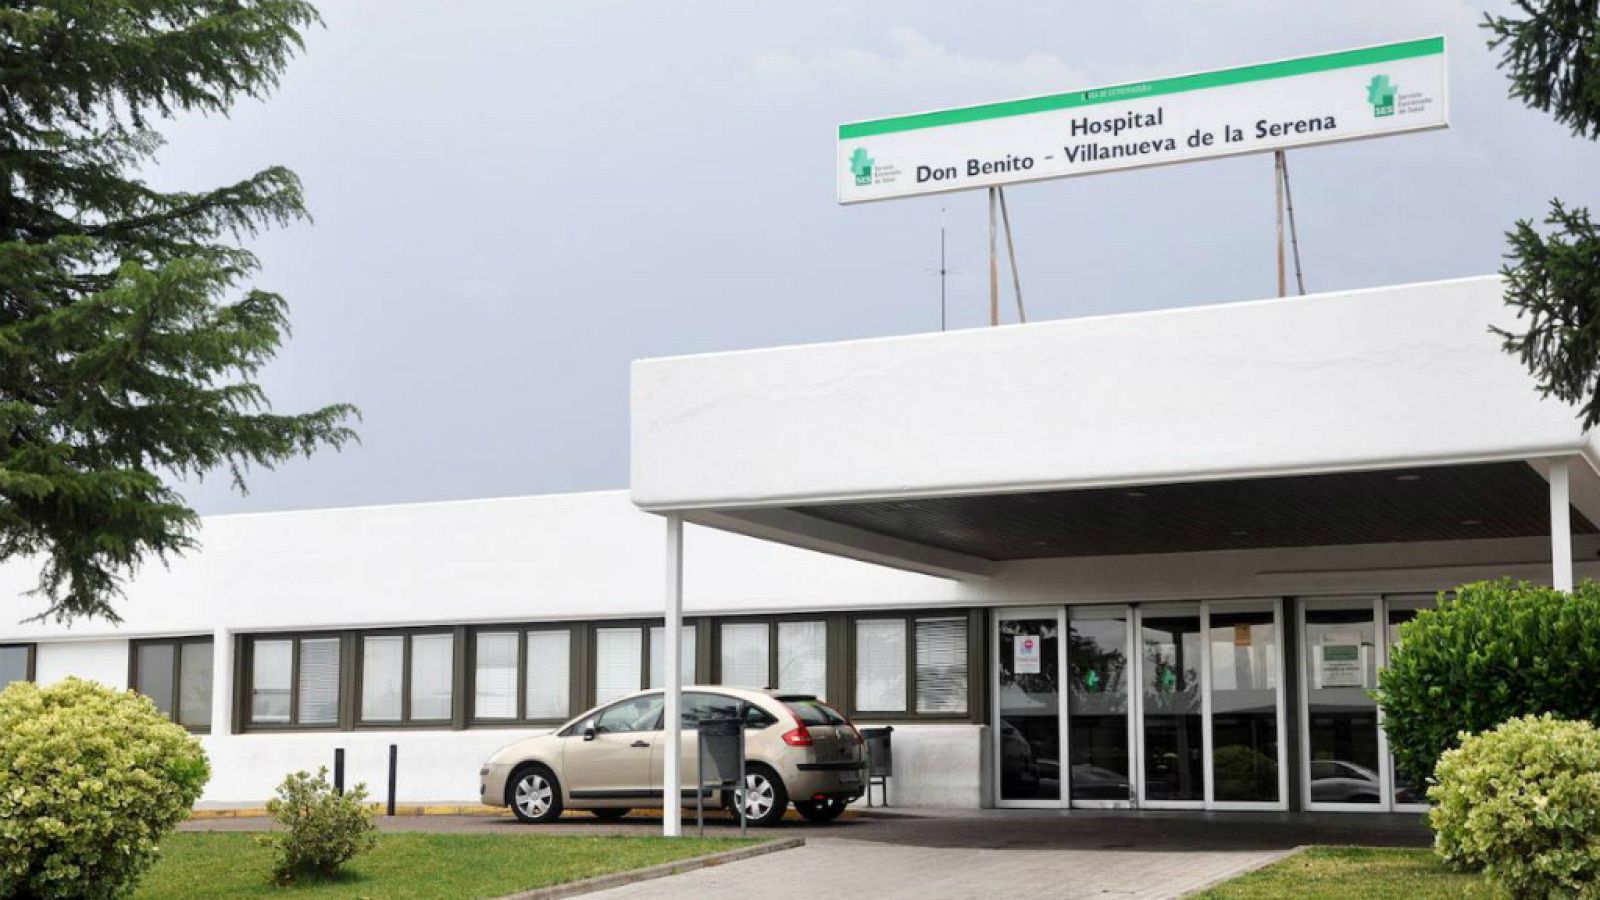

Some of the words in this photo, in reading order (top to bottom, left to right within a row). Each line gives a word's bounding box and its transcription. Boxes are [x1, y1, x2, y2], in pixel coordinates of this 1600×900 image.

[1071, 107, 1163, 137] Hospital
[916, 165, 957, 184] Don
[966, 154, 1034, 177] Benito
[1063, 138, 1176, 163] Villanueva
[1187, 129, 1214, 148] de
[1224, 124, 1244, 143] la
[1255, 116, 1337, 139] Serena
